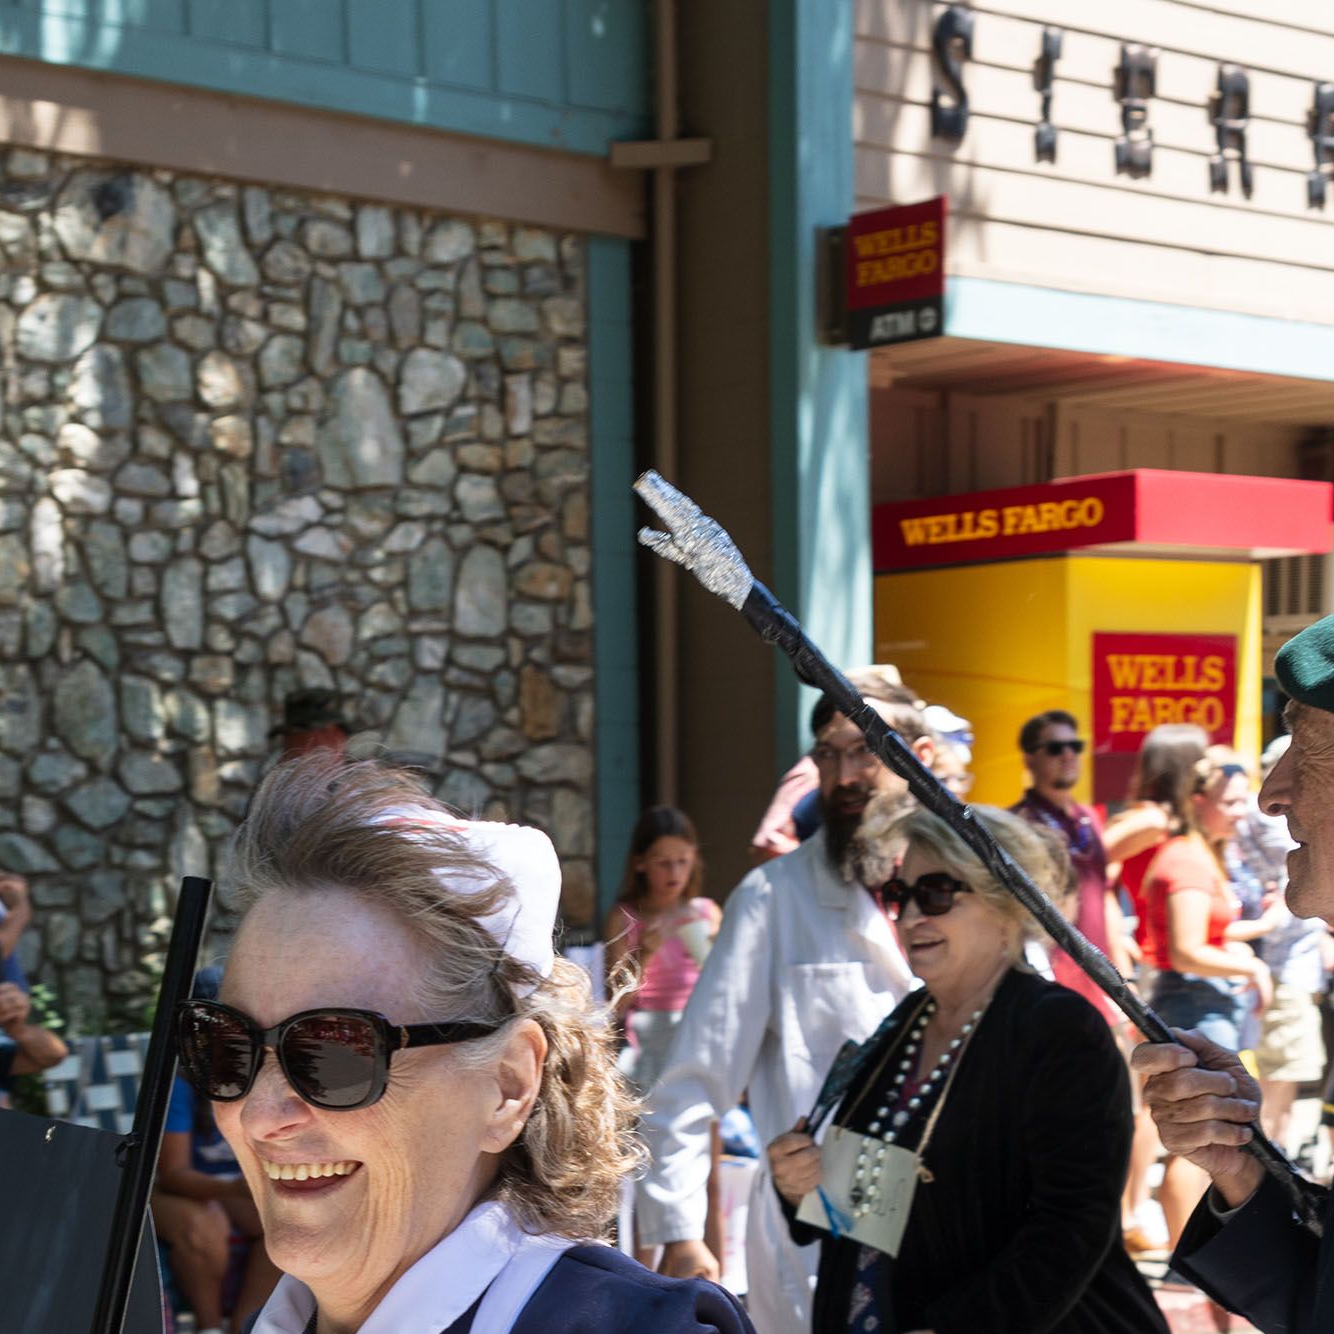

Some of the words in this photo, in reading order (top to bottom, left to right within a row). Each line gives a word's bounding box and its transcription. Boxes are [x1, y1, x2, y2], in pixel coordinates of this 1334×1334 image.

[854, 220, 938, 258] WELLS
[855, 249, 938, 288] FARGO
[868, 309, 917, 342] ATM
[900, 510, 999, 547] WELLS
[1002, 496, 1105, 536] FARGO
[1105, 653, 1226, 691] WELLS
[1108, 695, 1226, 734] FARGO
